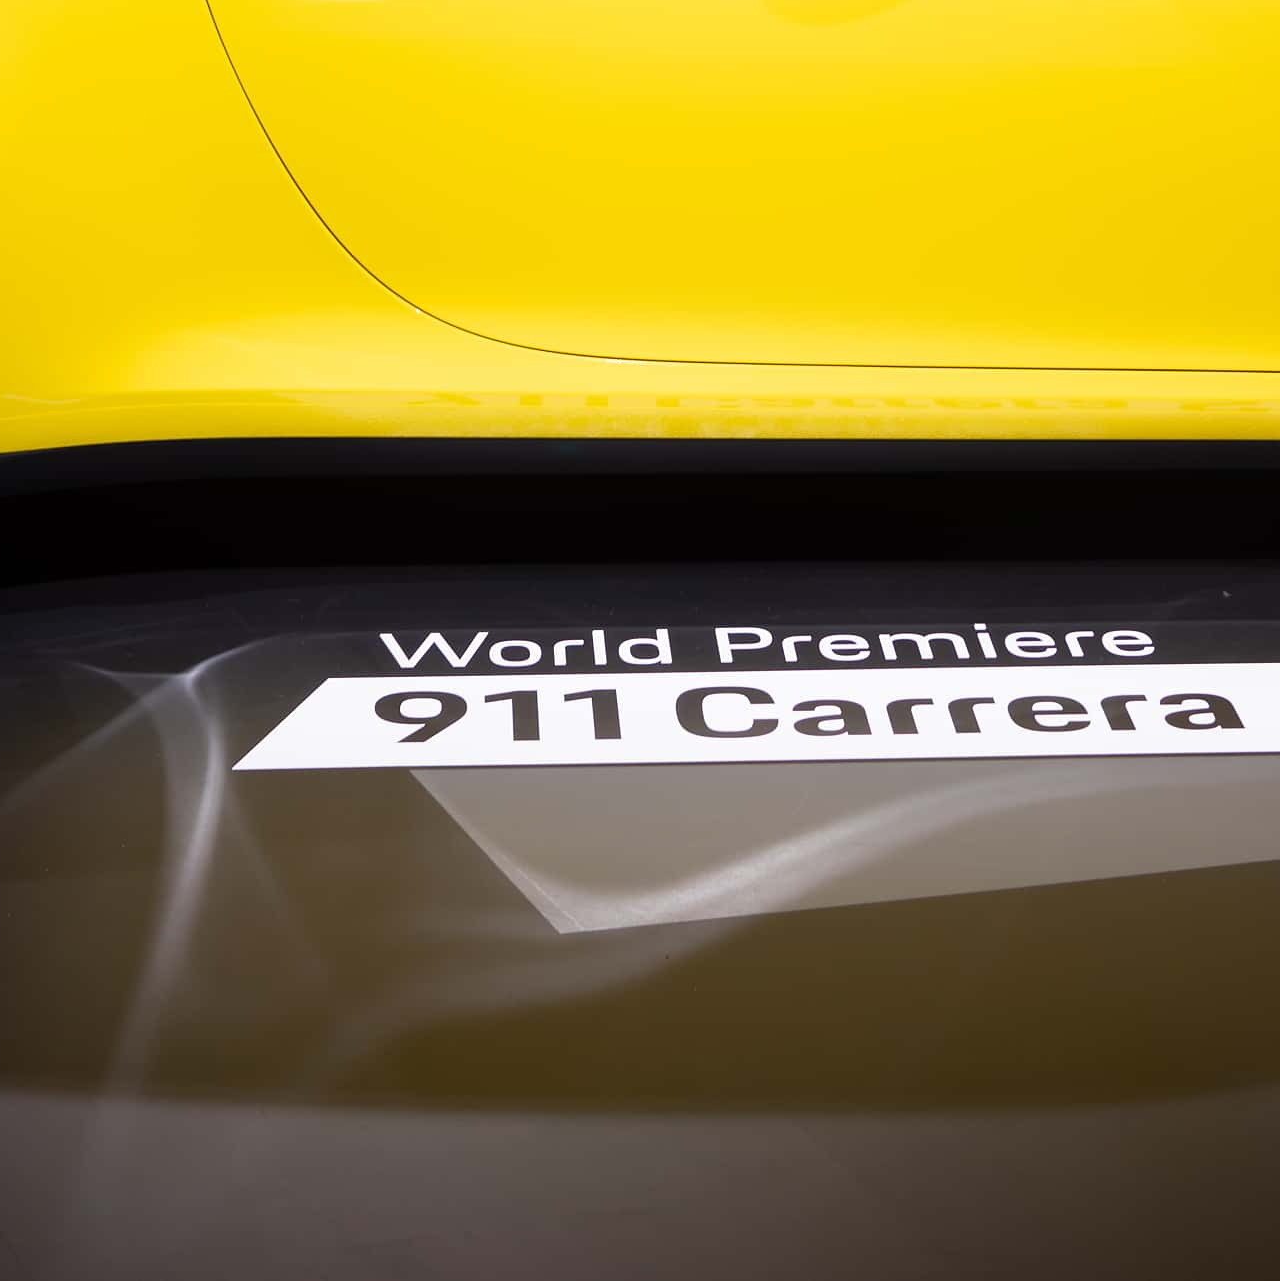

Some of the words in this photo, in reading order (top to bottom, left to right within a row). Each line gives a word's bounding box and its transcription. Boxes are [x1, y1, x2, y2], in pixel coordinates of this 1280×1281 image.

[380, 629, 673, 669] World
[715, 623, 1156, 664] Premiere
[375, 690, 622, 743] 911
[676, 687, 1247, 739] Carrera
